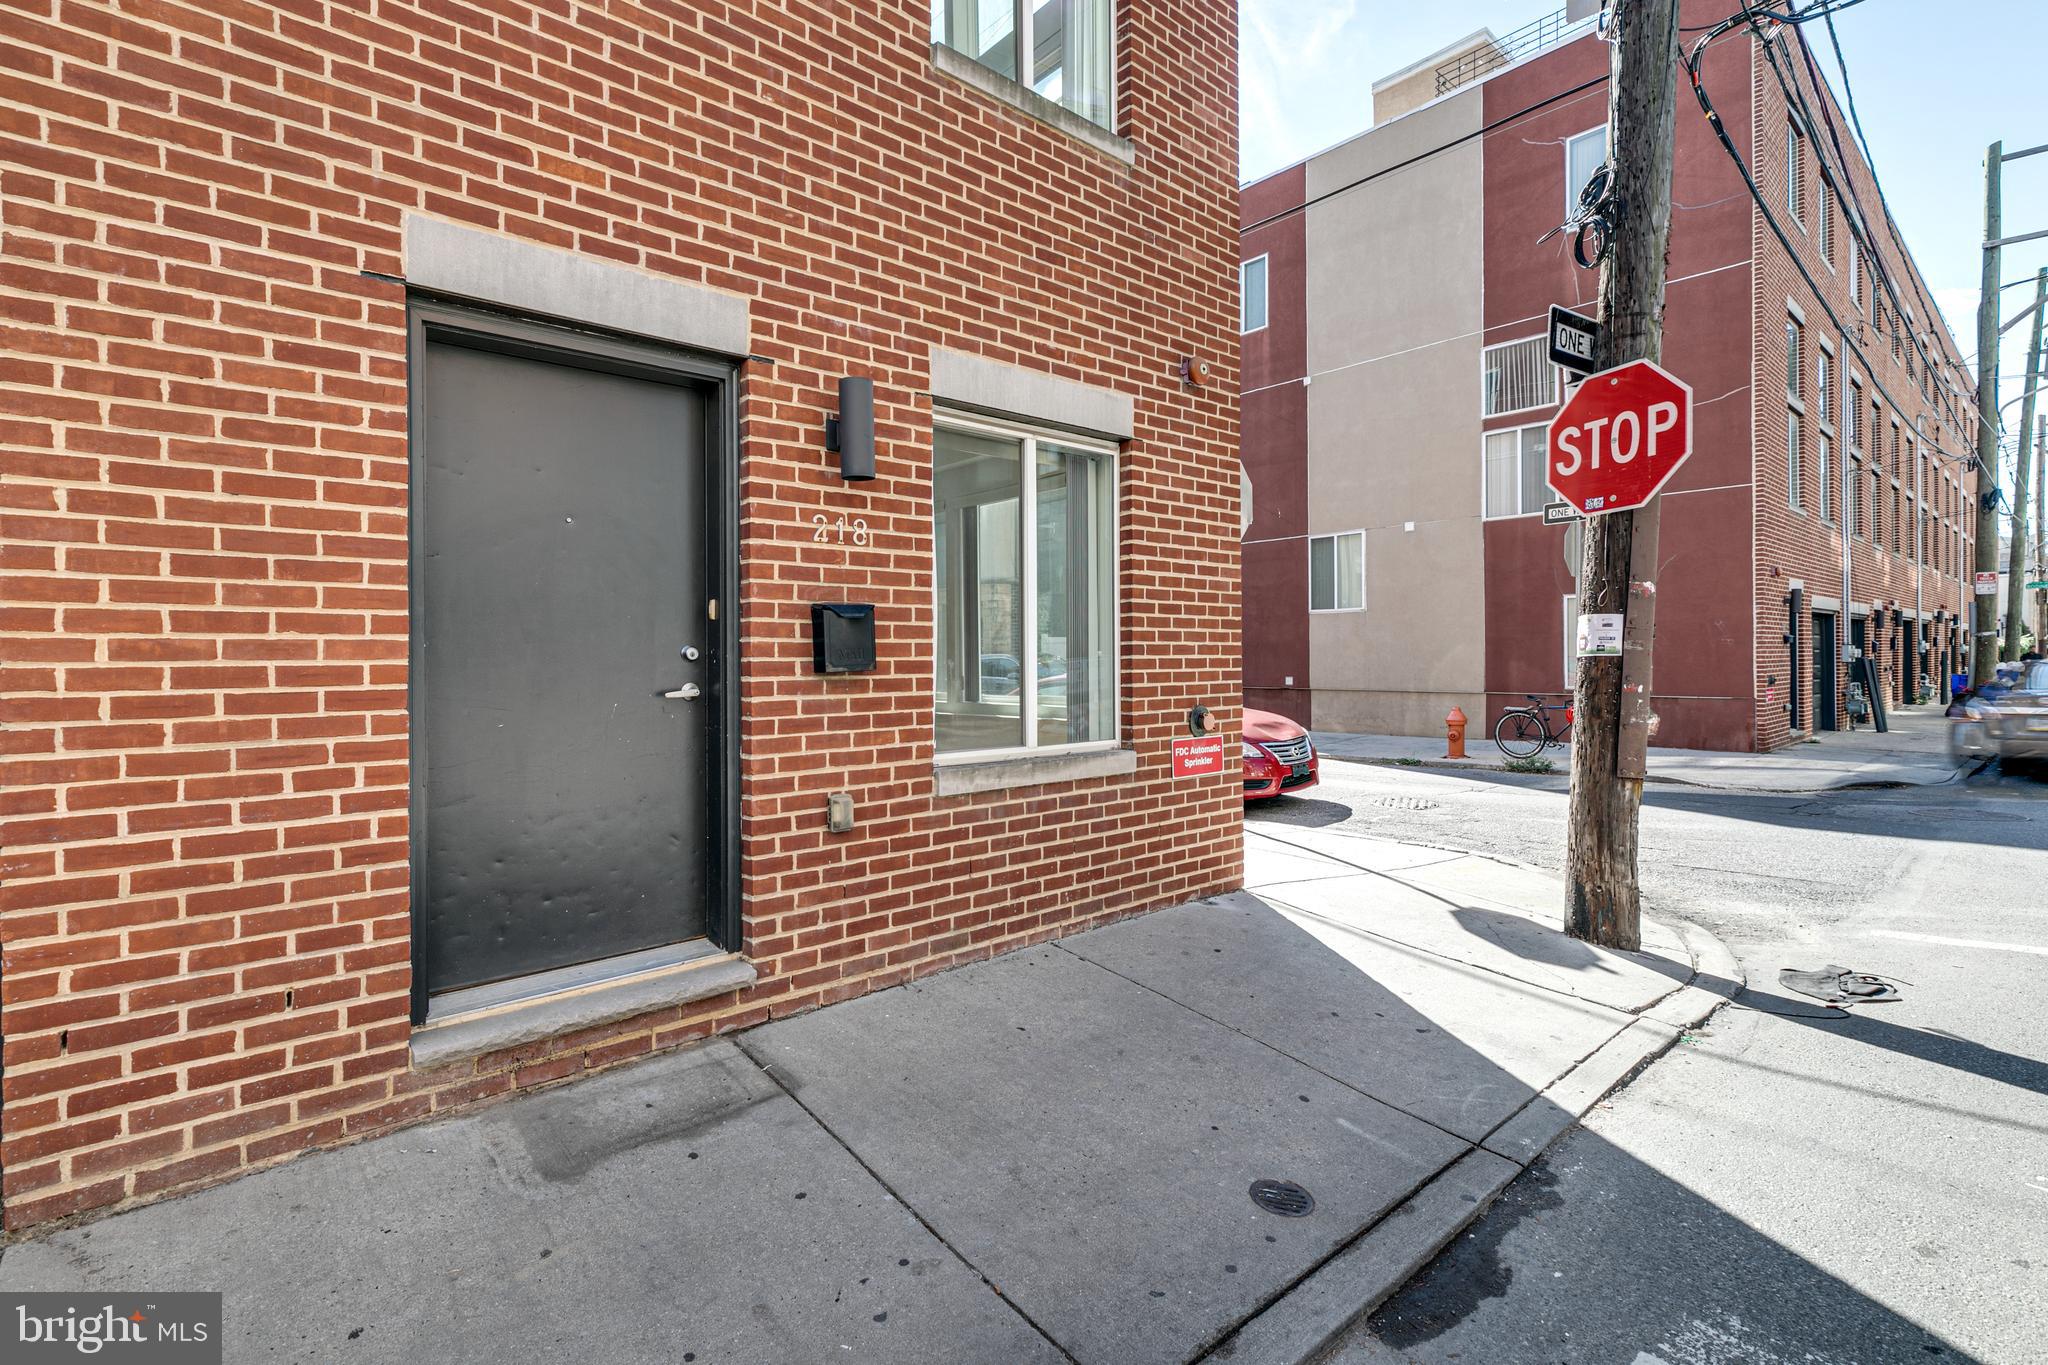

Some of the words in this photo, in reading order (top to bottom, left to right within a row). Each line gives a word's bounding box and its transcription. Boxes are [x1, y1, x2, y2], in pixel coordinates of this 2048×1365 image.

[1560, 327, 1585, 355] ONE
[1555, 401, 1679, 476] STOP
[1551, 507, 1570, 518] ONE
[812, 514, 868, 546] 218
[1175, 747, 1189, 756] FDC
[1190, 744, 1221, 755] Automatic
[1184, 757, 1213, 768] Sprinkler
